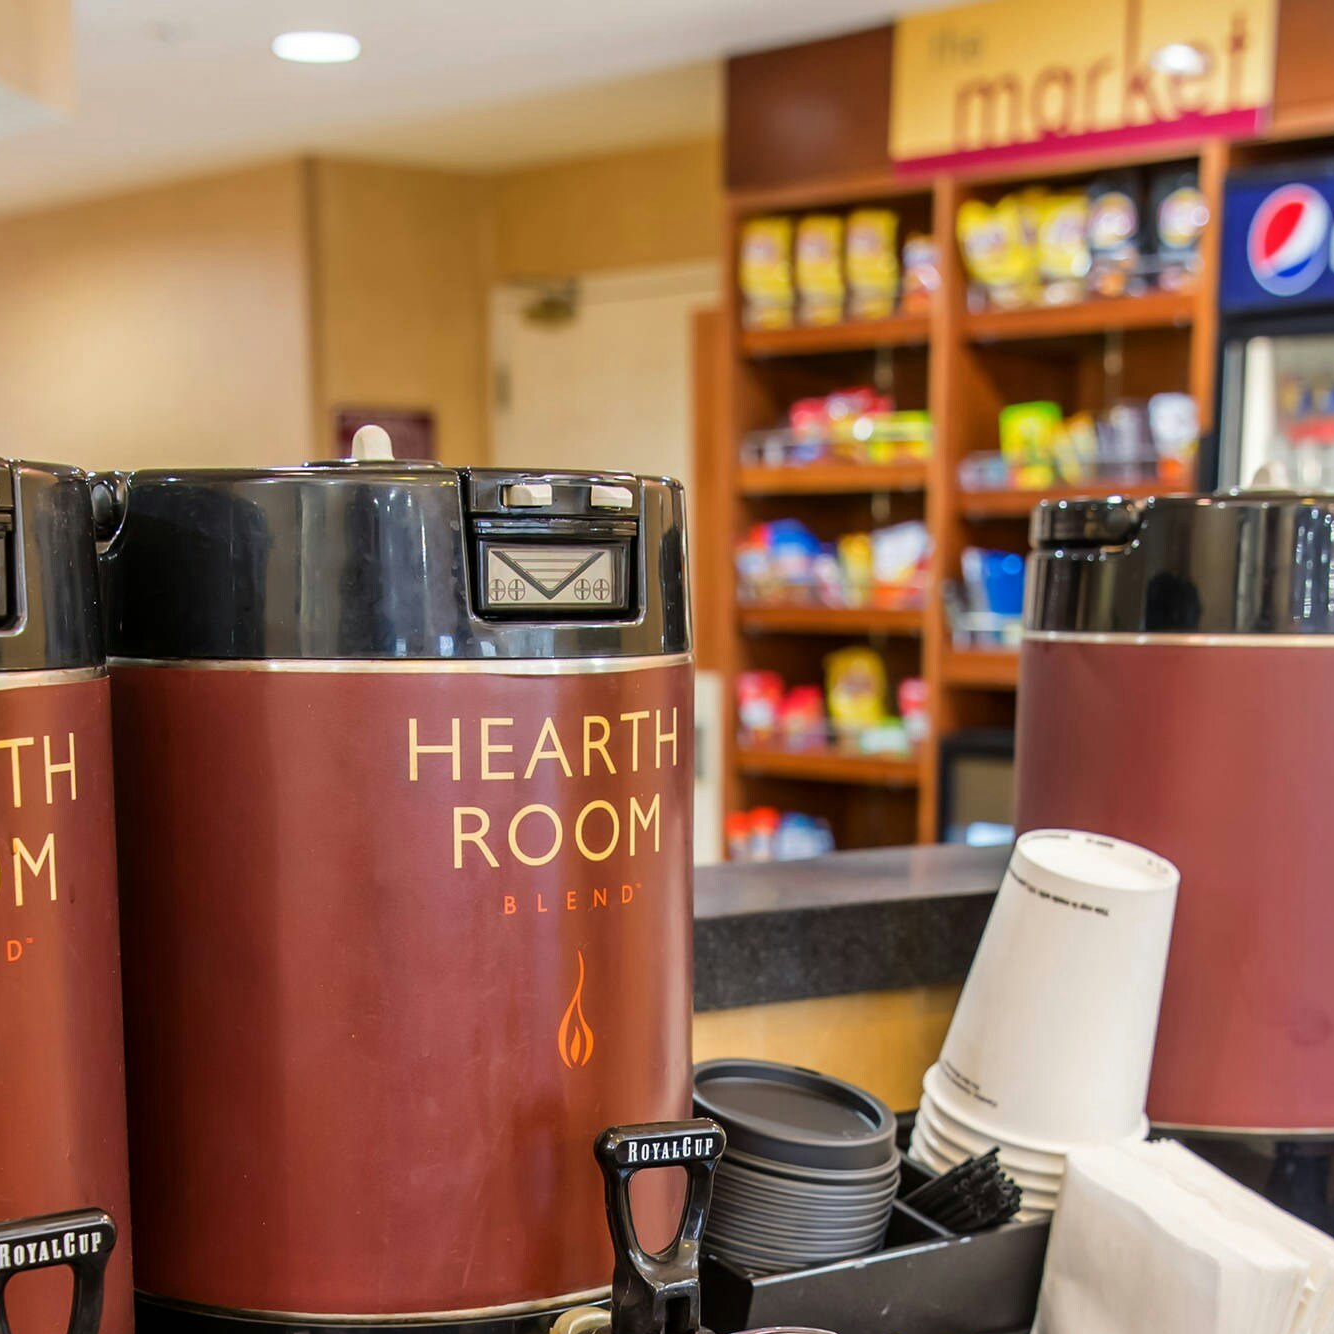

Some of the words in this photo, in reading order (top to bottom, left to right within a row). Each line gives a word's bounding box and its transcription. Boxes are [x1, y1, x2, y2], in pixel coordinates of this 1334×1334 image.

[409, 706, 678, 782] HEARTH
[453, 793, 661, 869] ROOM
[503, 885, 634, 915] BLEND
